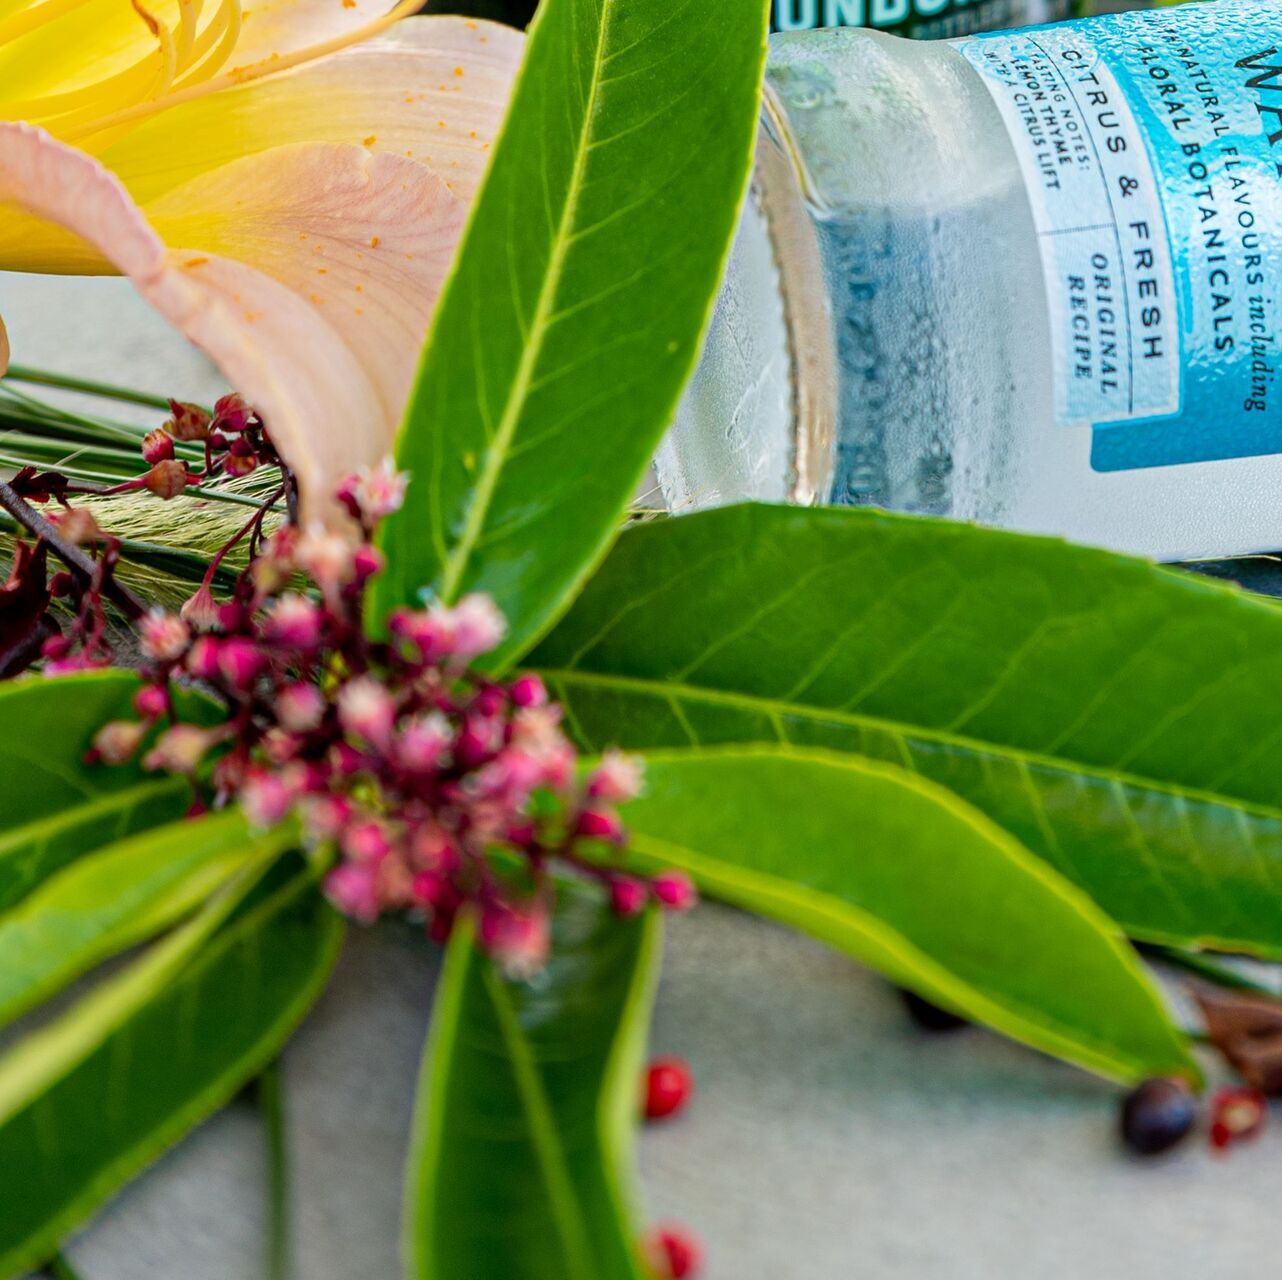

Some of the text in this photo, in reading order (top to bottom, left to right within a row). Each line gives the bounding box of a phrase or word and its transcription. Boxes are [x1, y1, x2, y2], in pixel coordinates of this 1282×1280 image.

[1010, 58, 1050, 102] LEMON
[1038, 104, 1073, 167] THYME
[1013, 92, 1048, 147] CITRUS
[1037, 151, 1062, 191] LIFT
[1029, 52, 1068, 103] TASTING
[1060, 109, 1092, 172] NOTES:
[1061, 49, 1164, 359] CITRUS & FRESH
[1136, 46, 1193, 132] FLORAL
[1180, 142, 1236, 352] BOTANICALS
[1175, 48, 1275, 413] NATURAL FLAVOURS including
[1068, 274, 1092, 380] RECIPE
[1091, 253, 1119, 394] ORIGINAL
